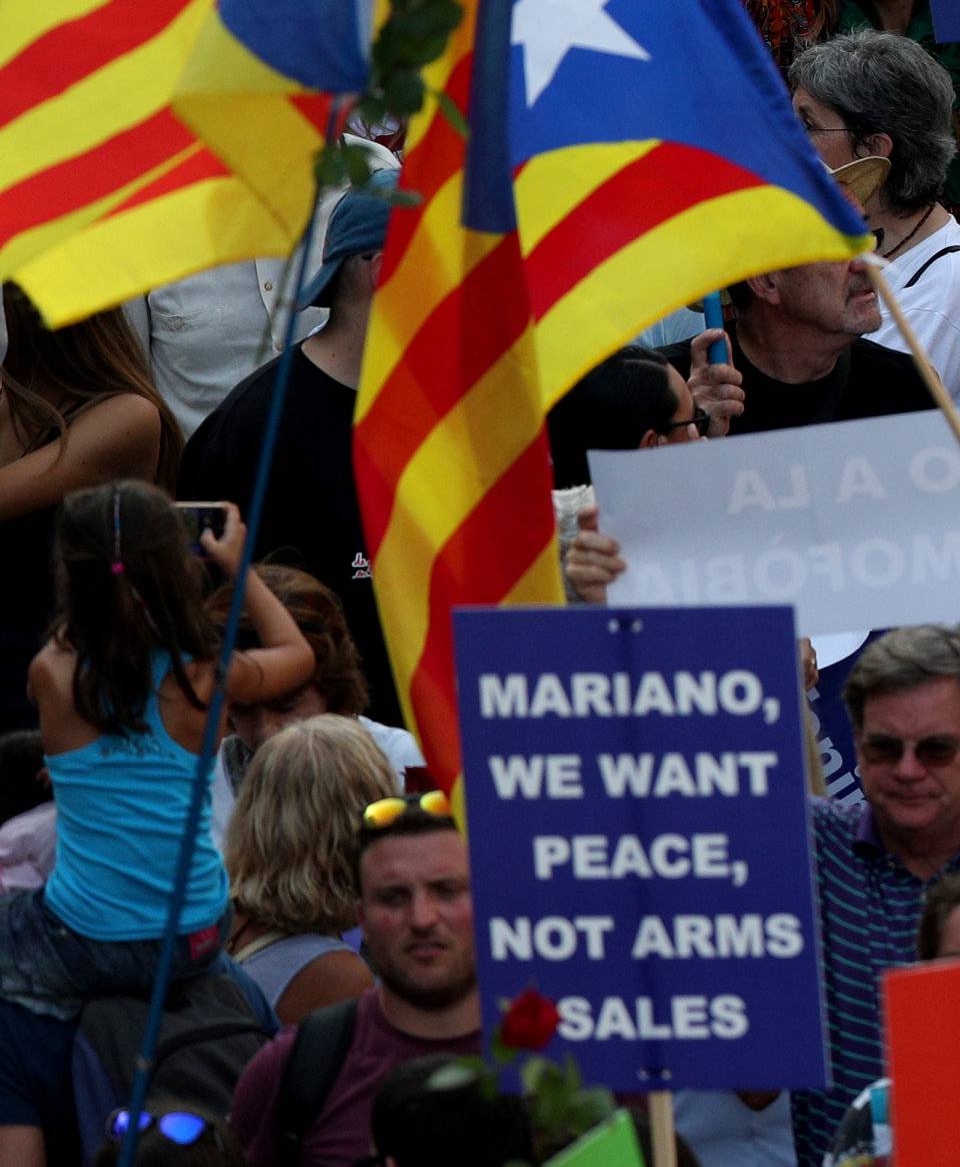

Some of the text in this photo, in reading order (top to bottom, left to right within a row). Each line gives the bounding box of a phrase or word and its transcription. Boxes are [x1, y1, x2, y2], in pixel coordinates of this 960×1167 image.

[479, 669, 780, 724] MARIANO,
[489, 751, 778, 800] WE WANT
[533, 833, 748, 887] PEACE,
[489, 912, 804, 961] NOT ARMS
[556, 994, 748, 1041] SALES
